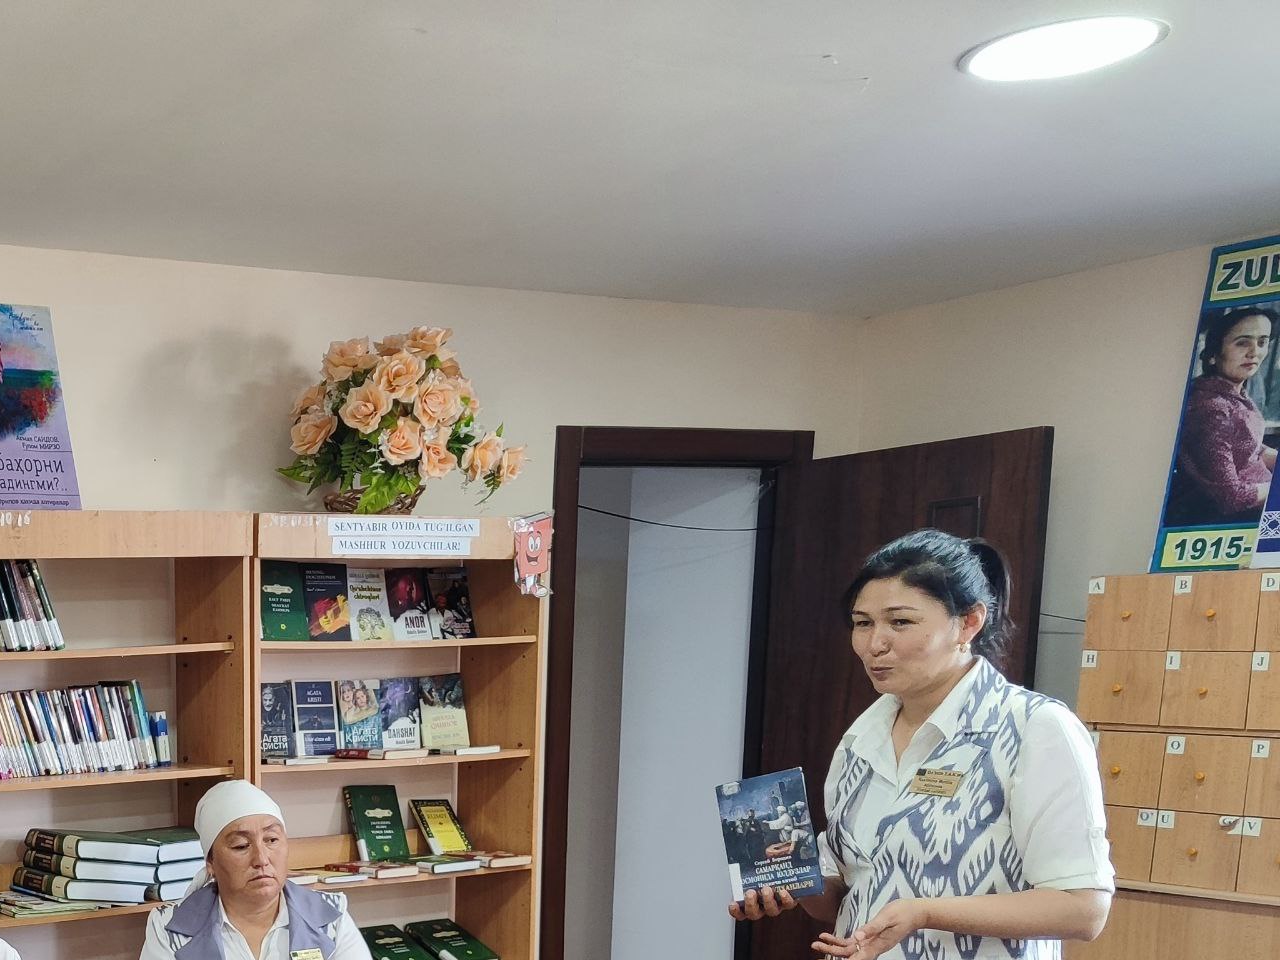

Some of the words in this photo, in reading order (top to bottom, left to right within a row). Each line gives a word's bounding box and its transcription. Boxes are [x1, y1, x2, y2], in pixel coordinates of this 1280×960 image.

[334, 521, 388, 533] SENTYABIR
[391, 520, 421, 531] OYIDA
[338, 540, 387, 550] MASHHUR
[405, 616, 426, 628] ANOR
[353, 727, 377, 735] Агата
[263, 734, 288, 743] Агата
[345, 734, 378, 744] Кристи
